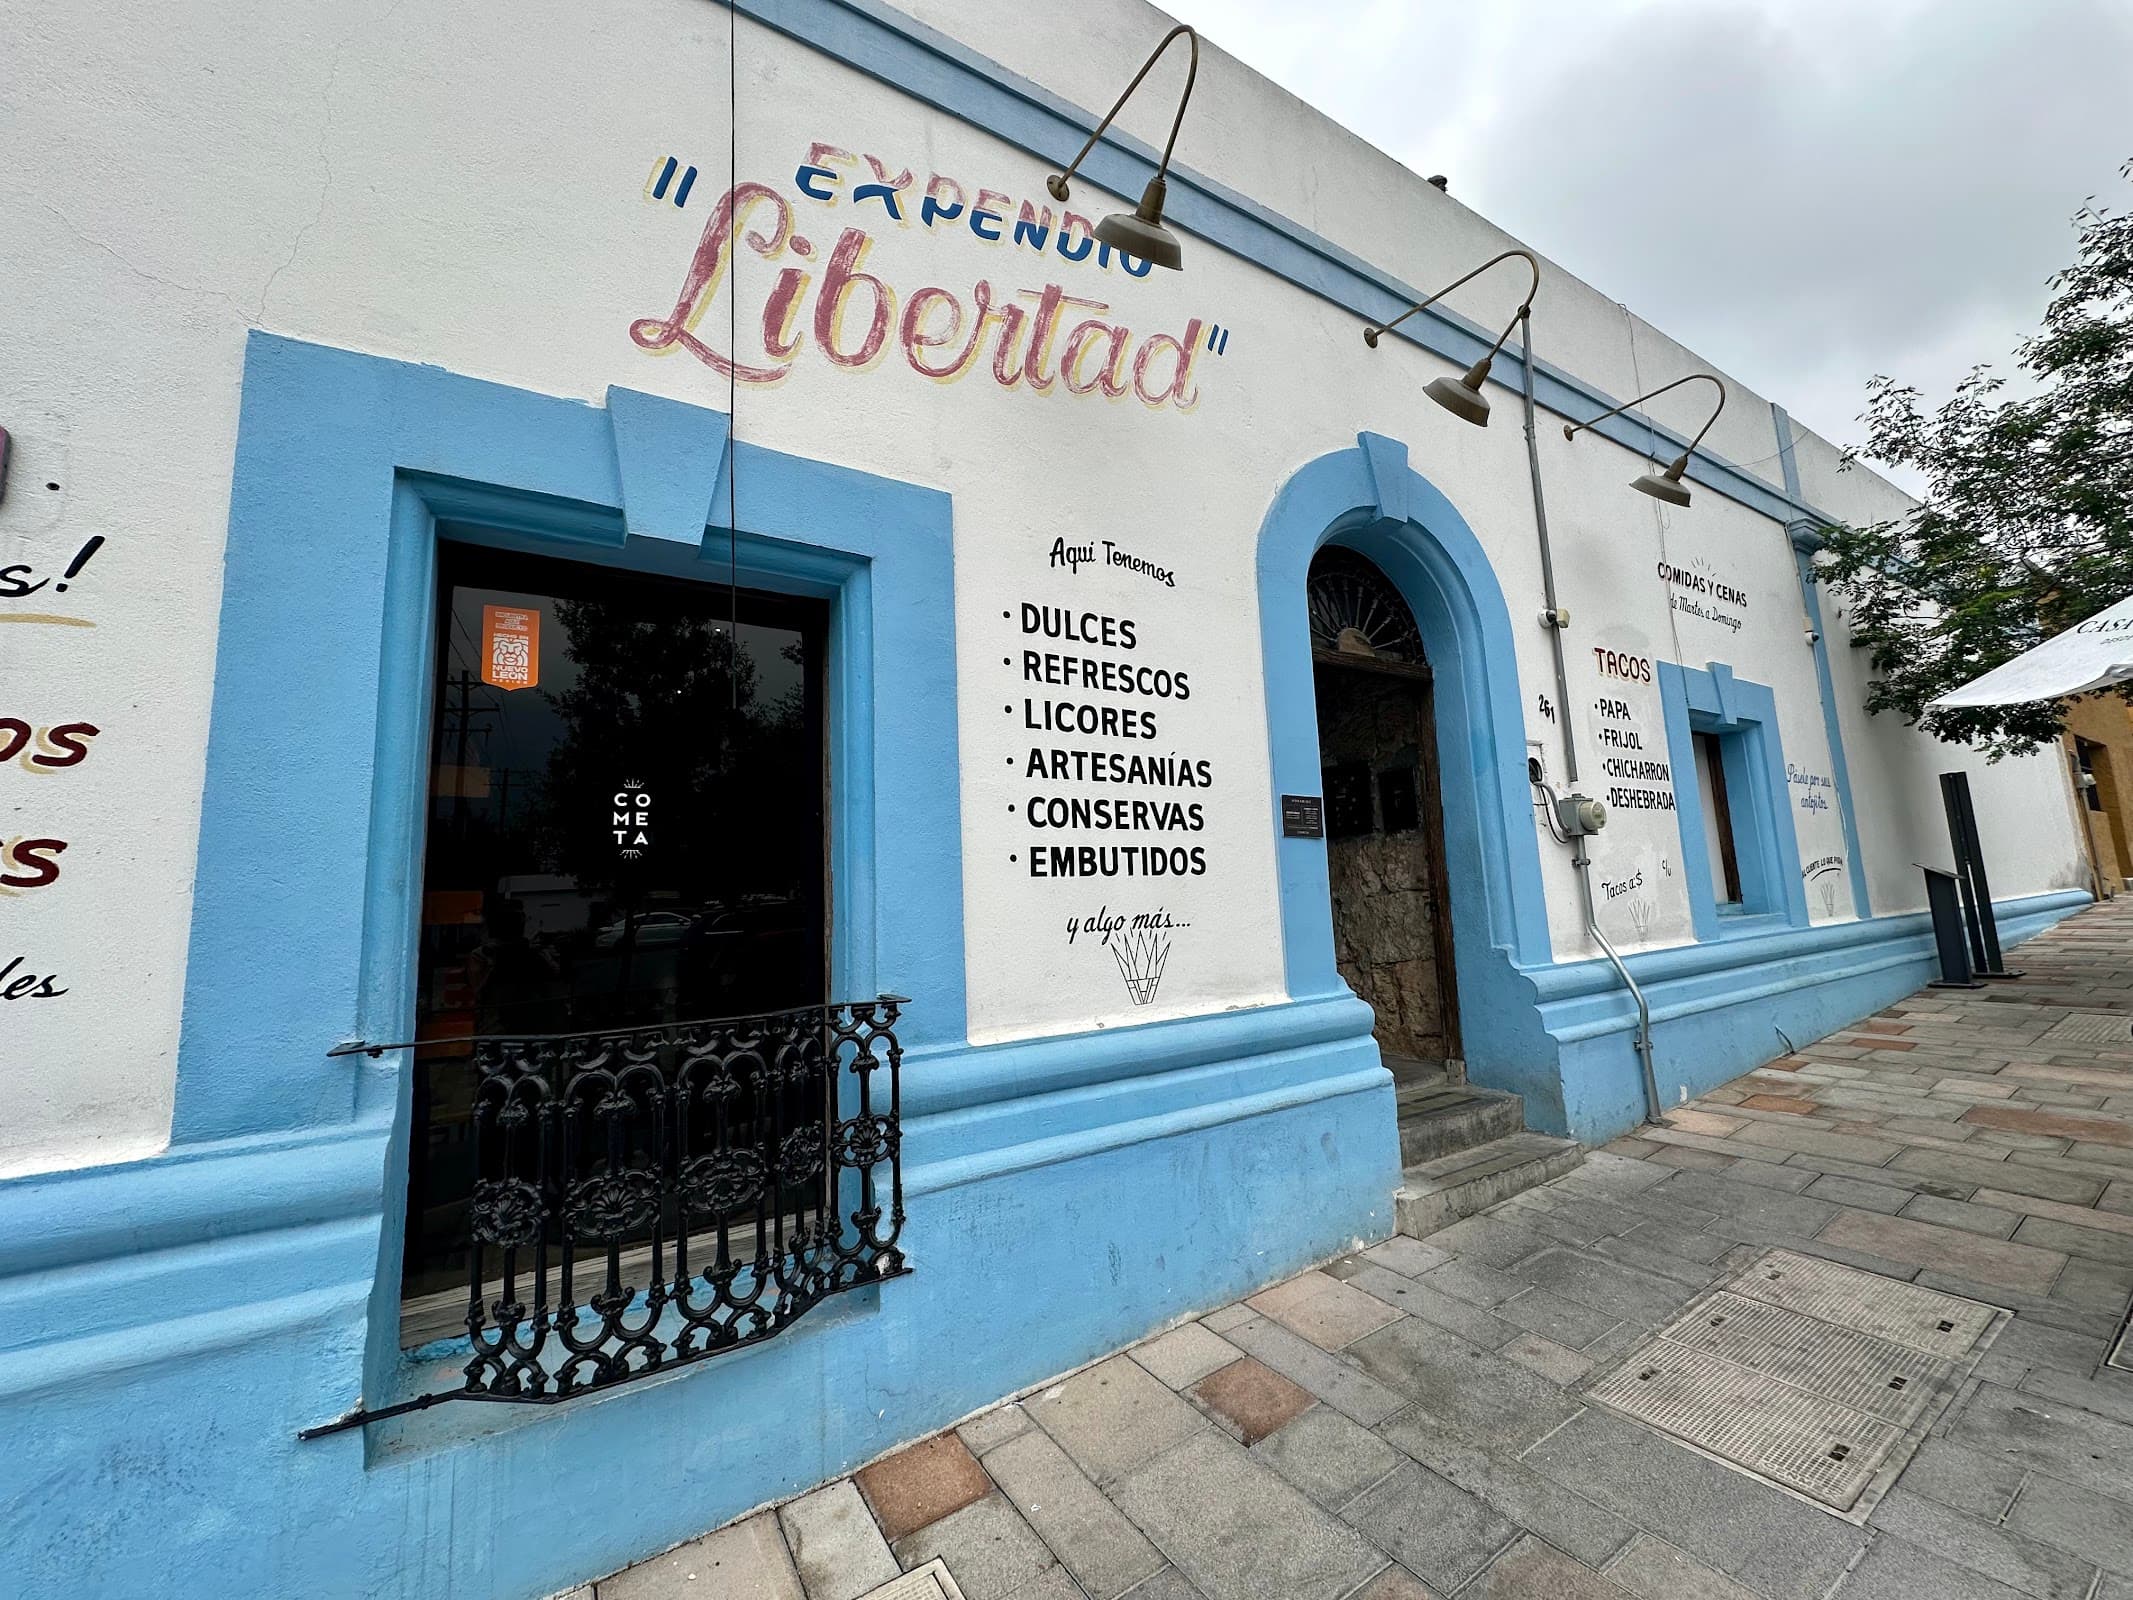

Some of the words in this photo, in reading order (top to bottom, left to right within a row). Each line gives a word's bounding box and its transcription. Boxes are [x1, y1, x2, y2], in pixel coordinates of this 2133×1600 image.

[1101, 540, 1176, 588] Tenemos
[1657, 561, 1706, 593] COMIDAS
[1707, 579, 1714, 596] Y
[1716, 583, 1748, 608] CENAS
[1021, 602, 1137, 650] DULCES
[1679, 595, 1704, 618] Martes
[1705, 609, 1711, 620] a
[1711, 606, 1742, 634] Domingo
[492, 664, 529, 673] NUEVO
[1023, 650, 1190, 700] REFRESCOS
[1593, 647, 1651, 683] TACOS
[1024, 698, 1157, 740] LICORES
[1538, 694, 1556, 725] 261
[1599, 698, 1632, 721] PAPA
[1603, 728, 1643, 751] FRIJOL
[1025, 747, 1212, 788] ARTESANÍAS
[1606, 758, 1670, 782] CHICHARRON
[1027, 796, 1205, 832] CONSERVAS
[1610, 787, 1676, 811] DESHEBRADA
[1030, 846, 1207, 878] EMBUTIDOS
[1601, 880, 1627, 901] Tacos
[1066, 917, 1079, 945] y
[1083, 905, 1127, 946] algo
